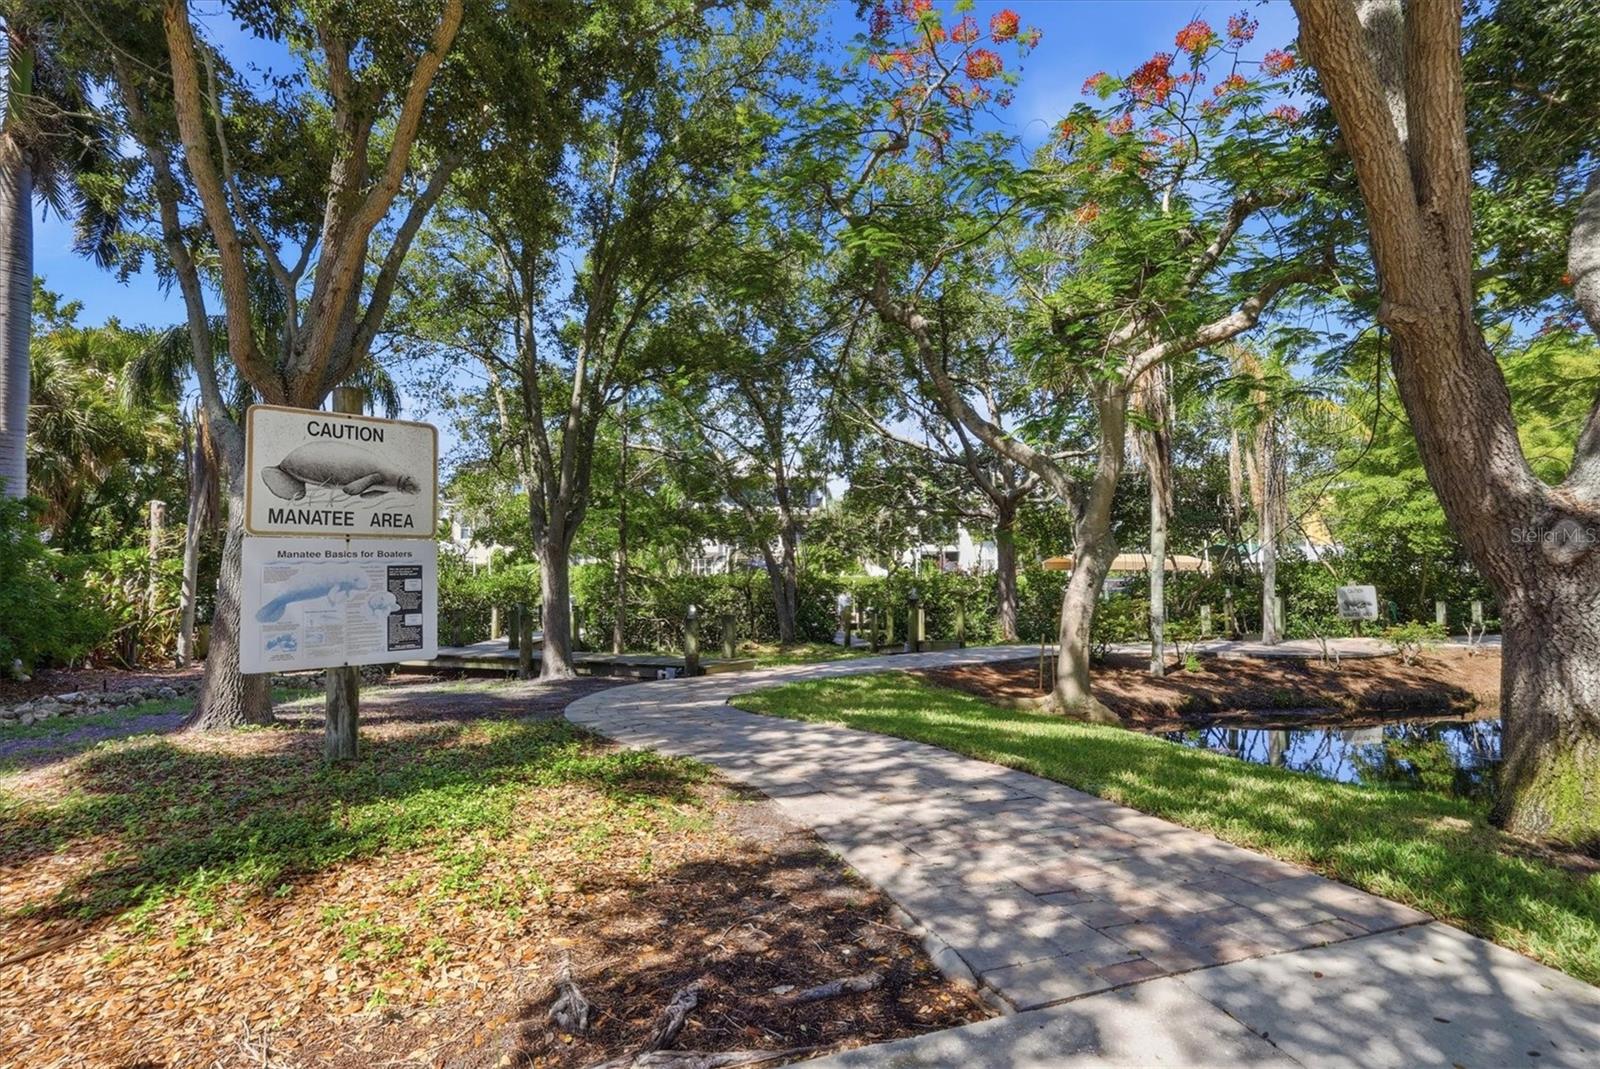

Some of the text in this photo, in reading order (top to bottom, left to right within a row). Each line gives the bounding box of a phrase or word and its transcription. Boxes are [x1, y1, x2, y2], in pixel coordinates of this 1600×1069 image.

[307, 421, 384, 442] CAUTION
[268, 508, 414, 528] MANATEE AREA
[277, 550, 413, 558] Manatee Basics for Boaters
